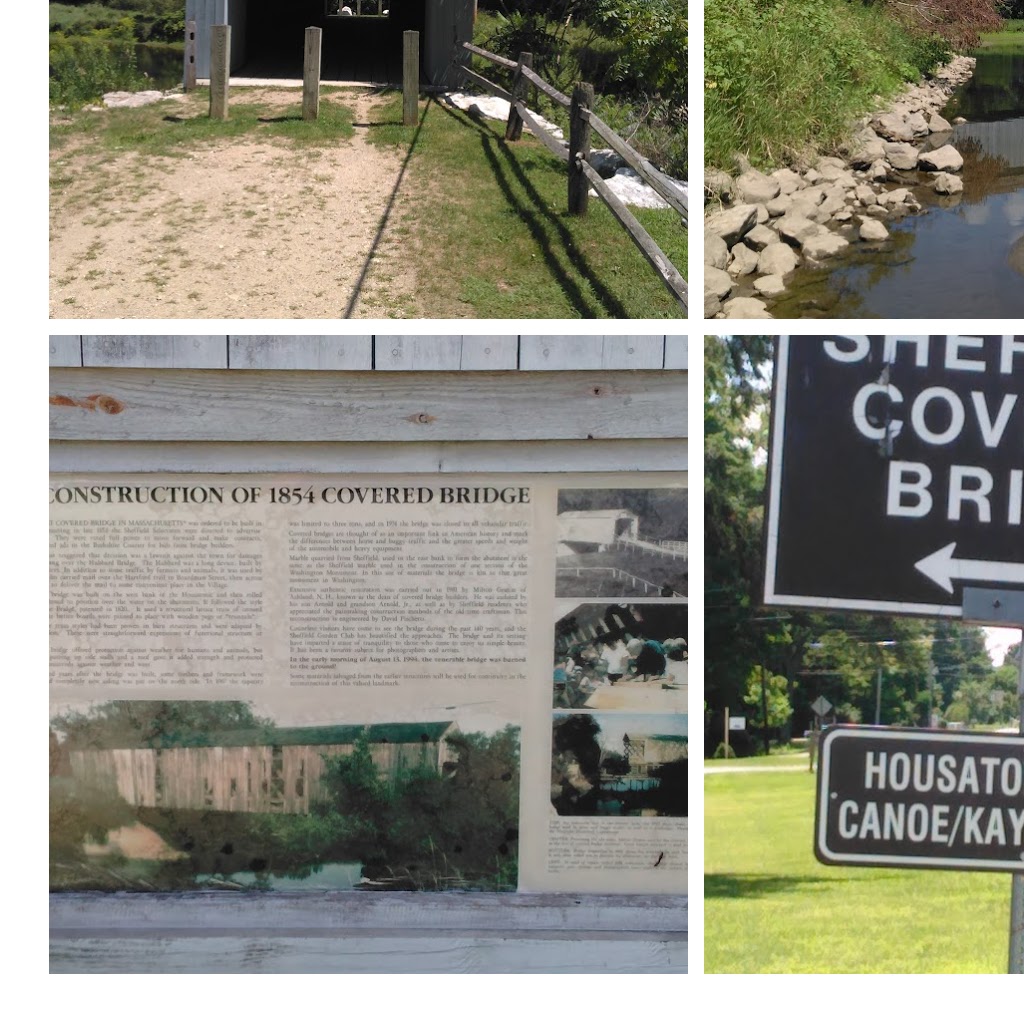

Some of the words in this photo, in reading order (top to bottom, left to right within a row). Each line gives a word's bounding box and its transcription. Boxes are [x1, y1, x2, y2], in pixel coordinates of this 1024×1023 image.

[231, 486, 261, 504] OF
[269, 484, 315, 504] 1854
[321, 486, 434, 504] COVERED
[440, 486, 530, 504] BRIDGE
